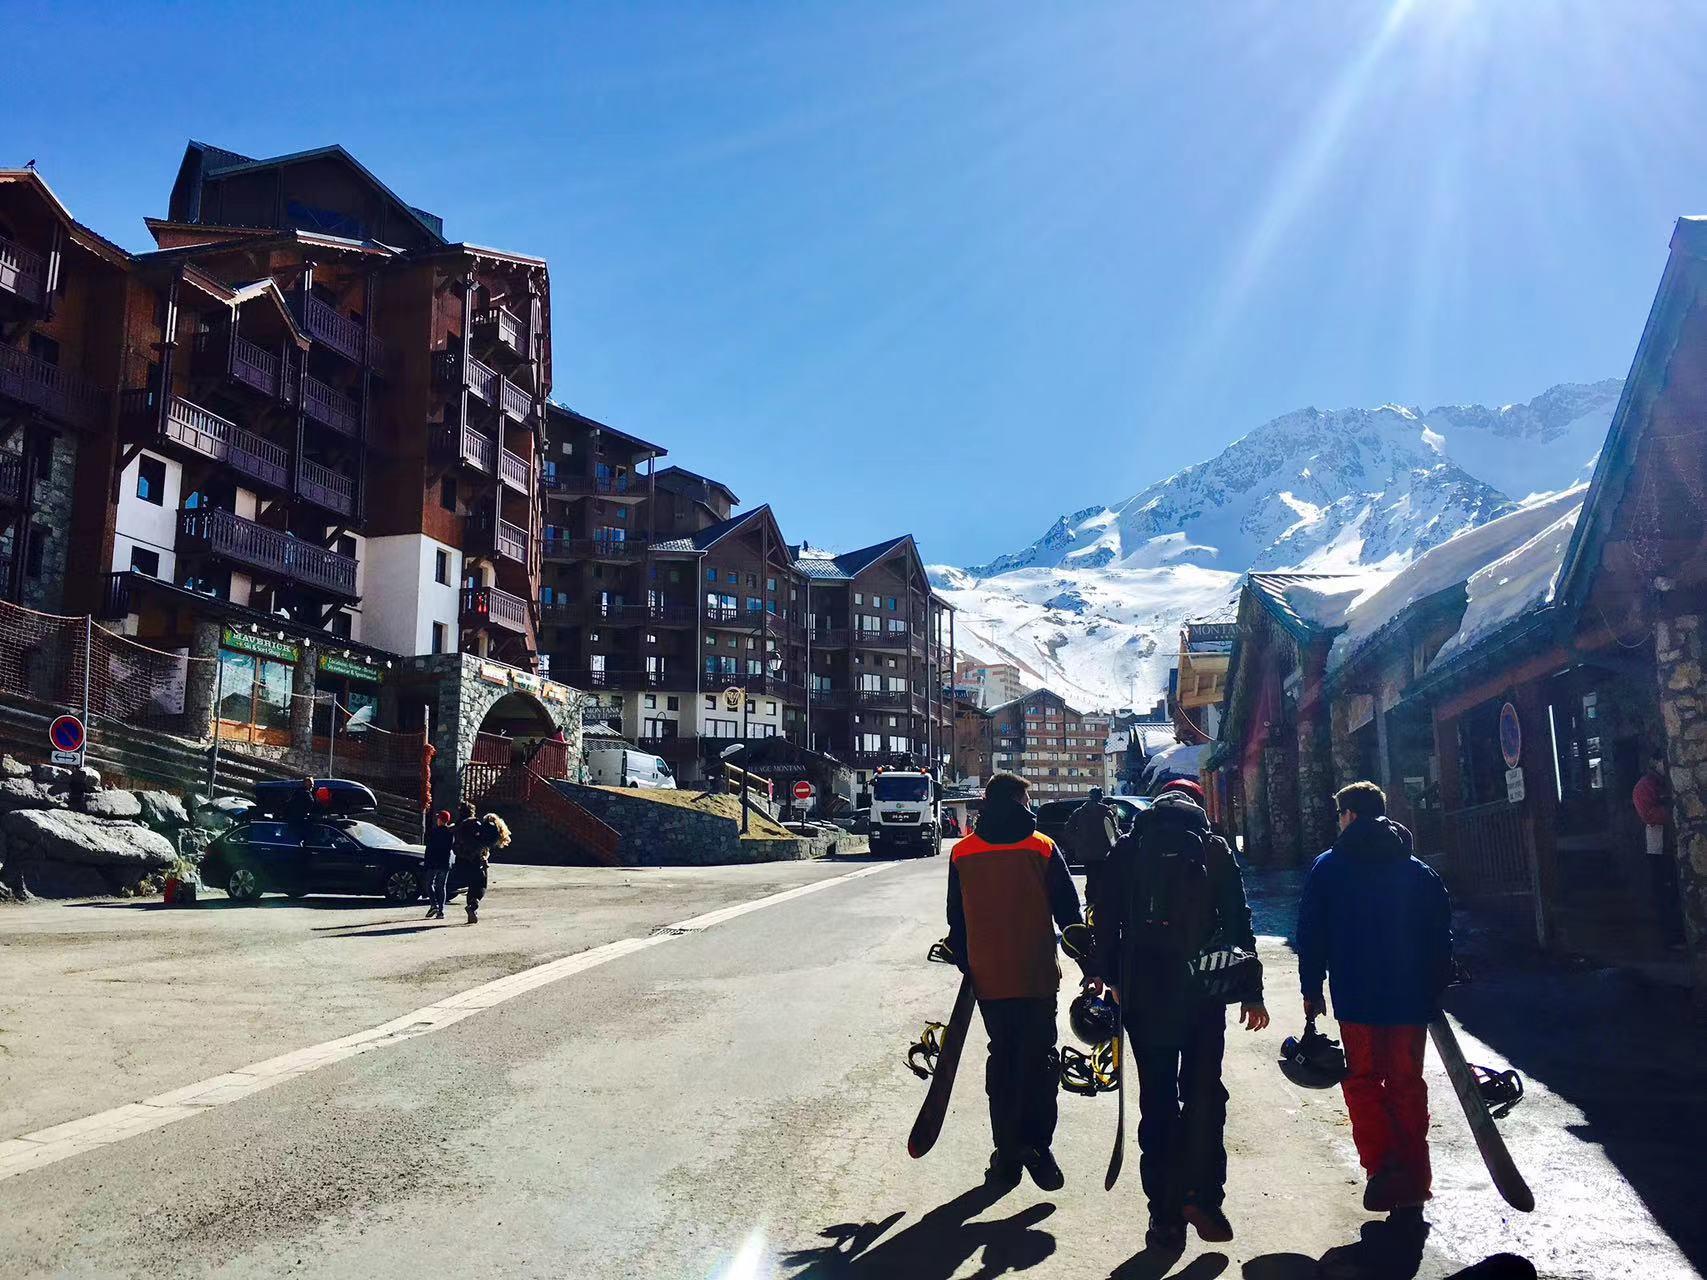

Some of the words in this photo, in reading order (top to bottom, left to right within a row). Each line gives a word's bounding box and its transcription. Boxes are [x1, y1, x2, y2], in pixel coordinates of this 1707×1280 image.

[1192, 623, 1253, 635] MONTANA
[232, 633, 291, 653] MAVERICK
[773, 764, 807, 772] MONTANA
